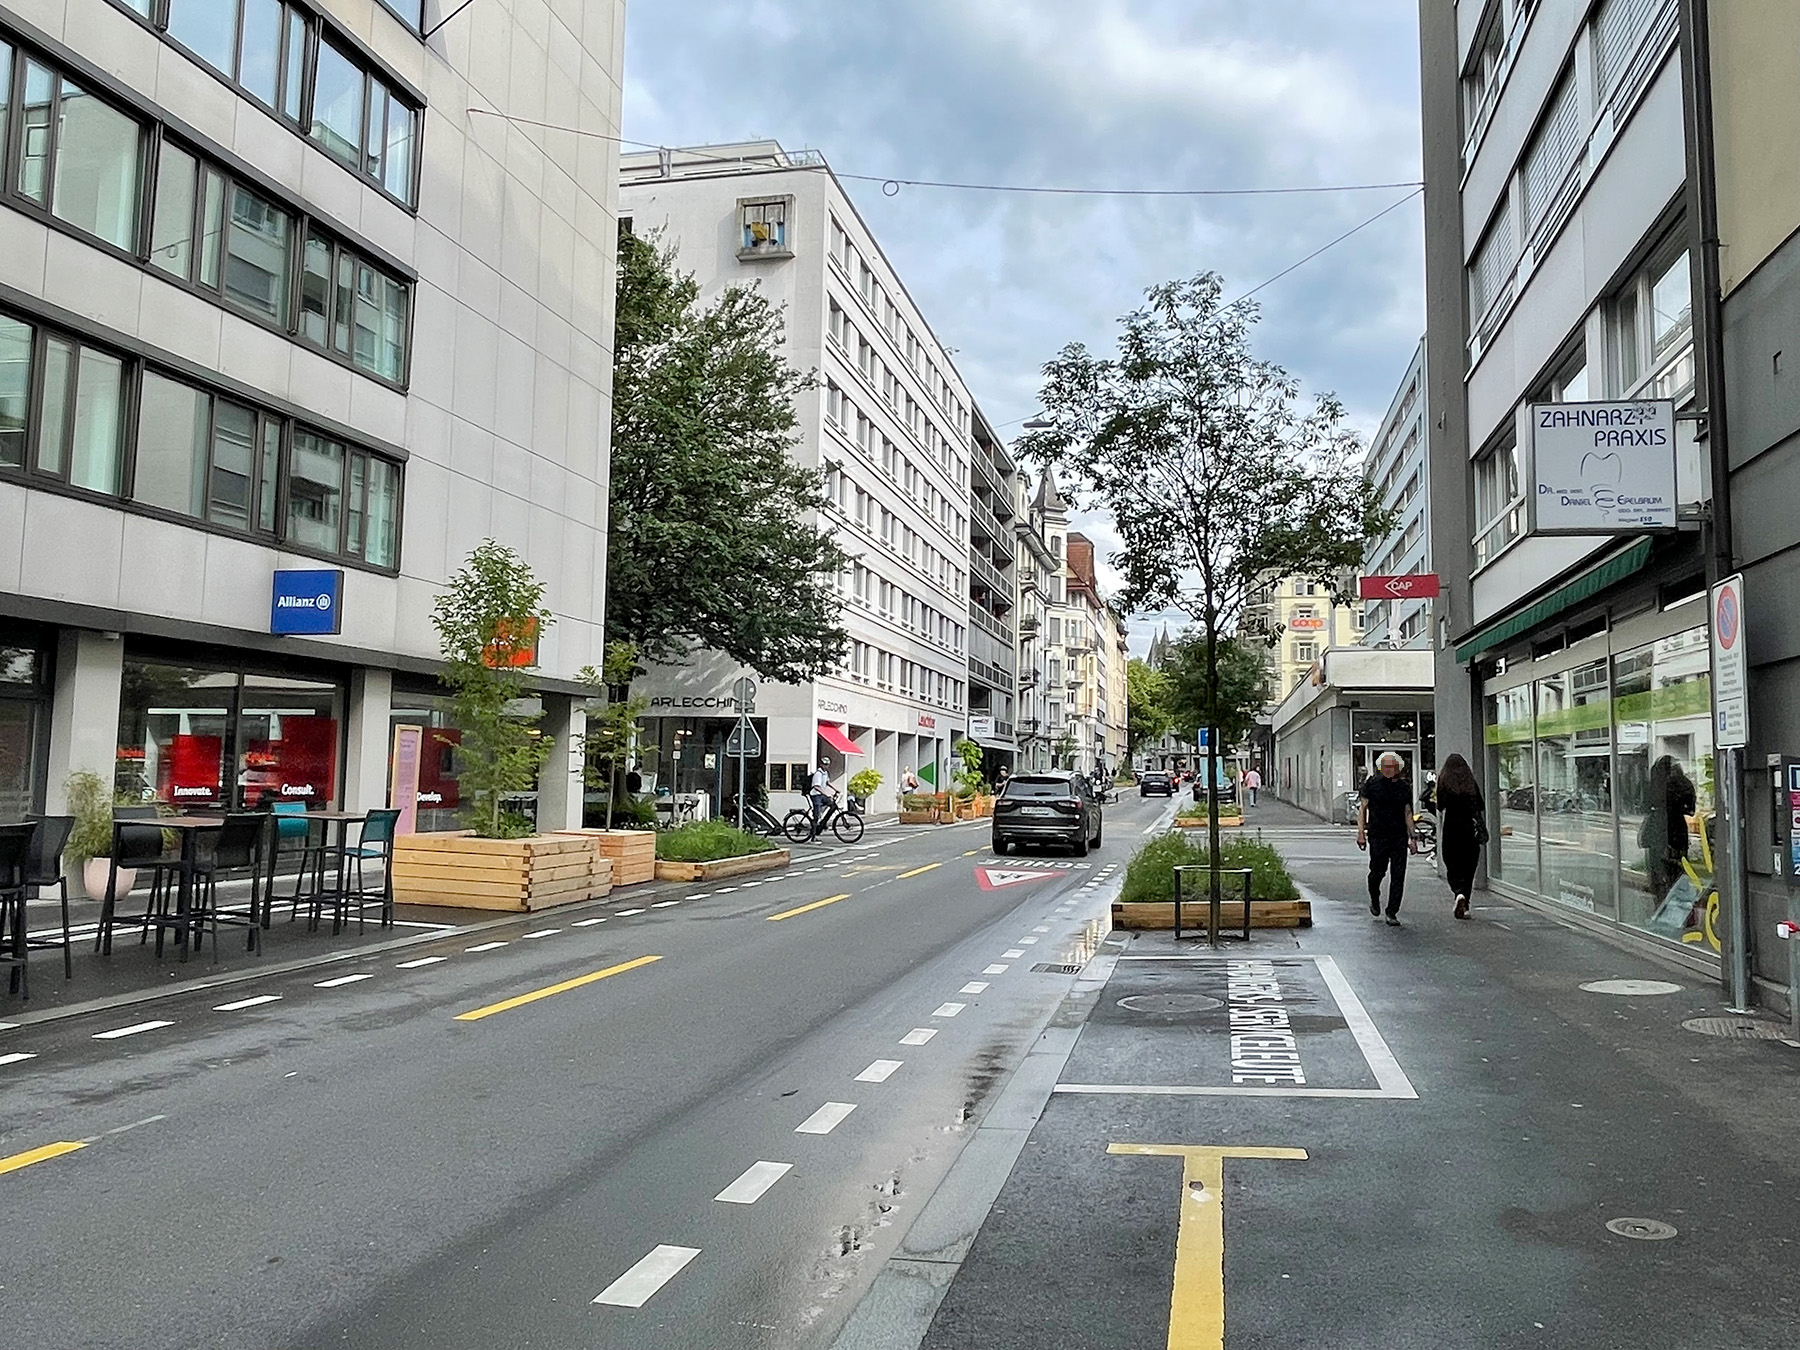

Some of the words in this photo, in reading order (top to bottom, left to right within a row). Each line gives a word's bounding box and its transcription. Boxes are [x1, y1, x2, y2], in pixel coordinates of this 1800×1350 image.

[1595, 428, 1667, 447] PRAXIS
[1391, 582, 1413, 591] CAP
[277, 596, 315, 607] Allianz
[1292, 619, 1323, 629] coop
[651, 697, 754, 708] ARLECCHIN
[174, 786, 212, 796] Innovate.
[282, 784, 315, 795] Consult.
